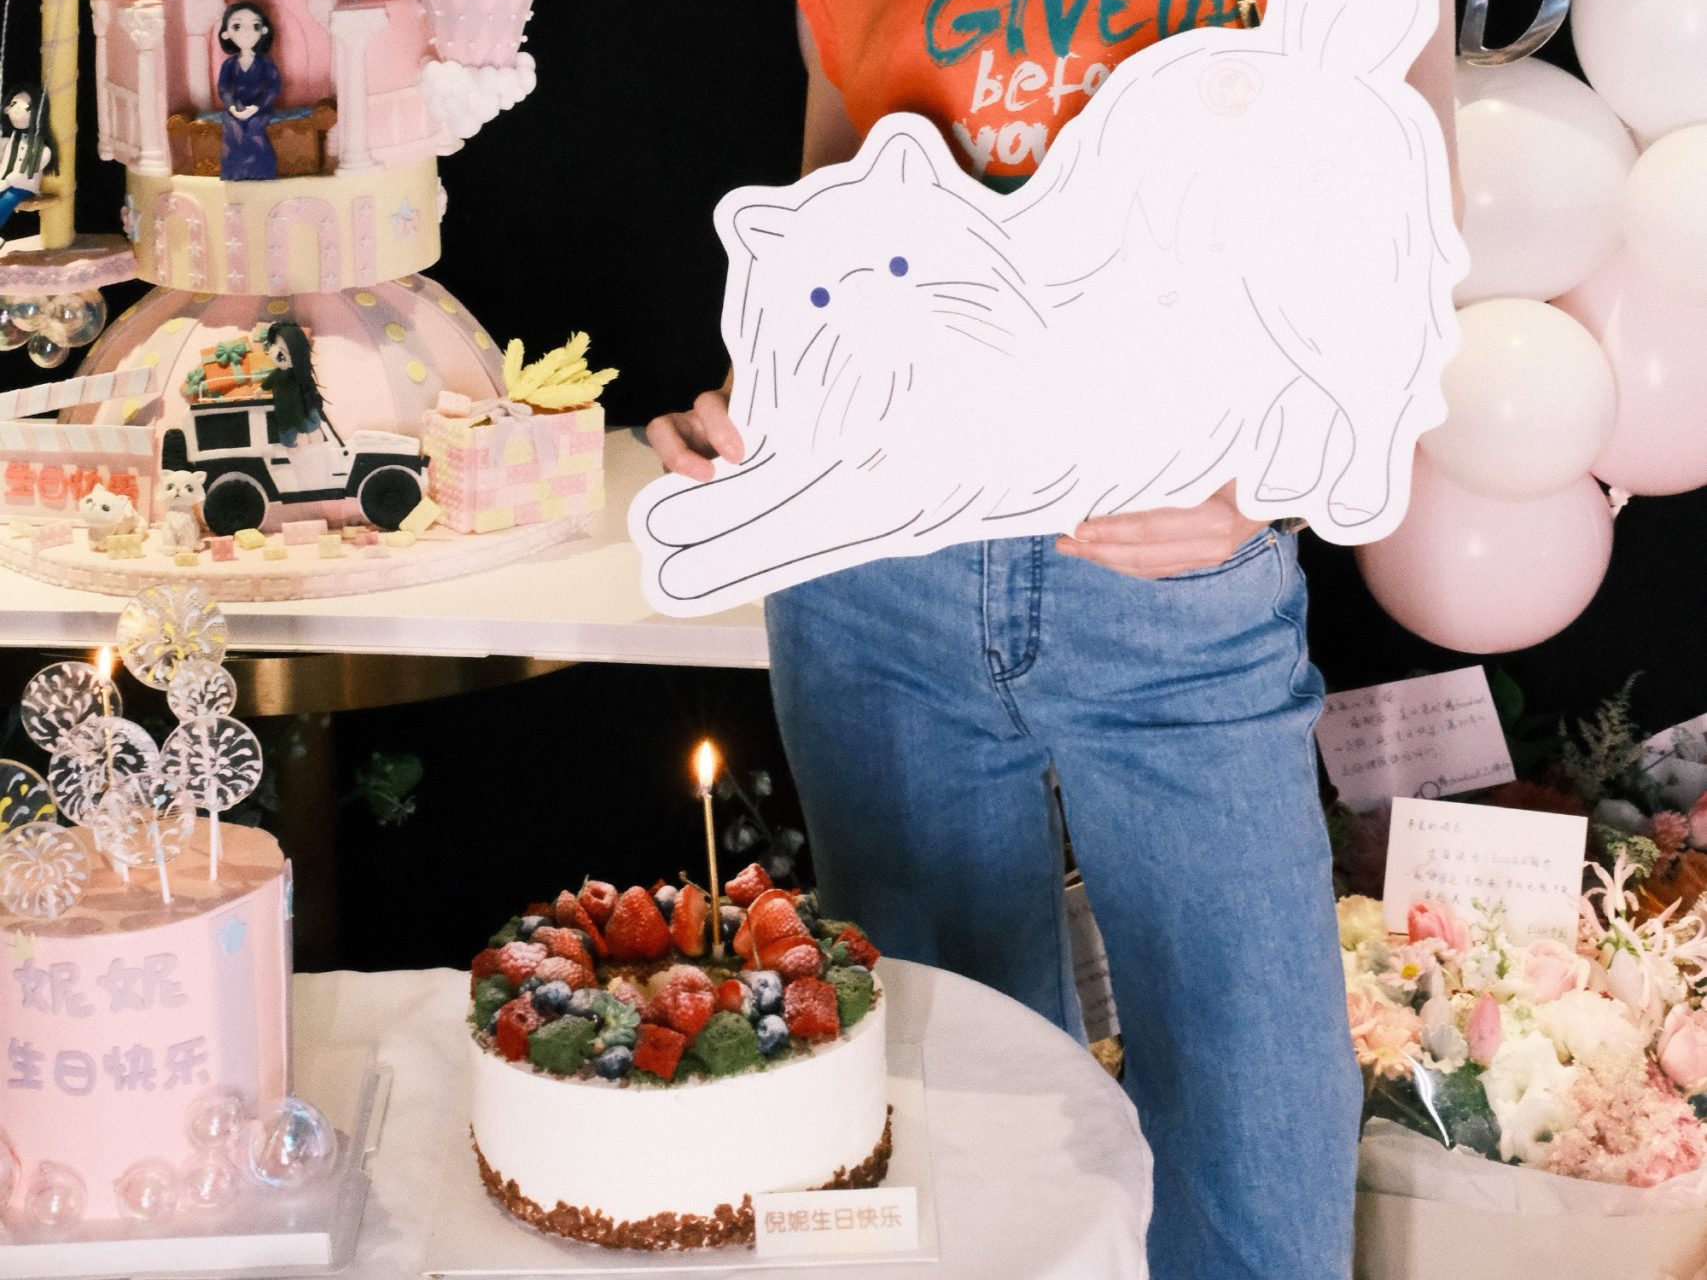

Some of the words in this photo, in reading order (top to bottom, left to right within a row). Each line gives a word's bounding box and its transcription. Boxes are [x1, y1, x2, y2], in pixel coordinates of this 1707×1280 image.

[970, 49, 1121, 116] befo
[13, 952, 190, 1018] 妮妮
[7, 1035, 210, 1097] 生日快乐
[764, 1204, 903, 1234] 倪妮生日快乐
